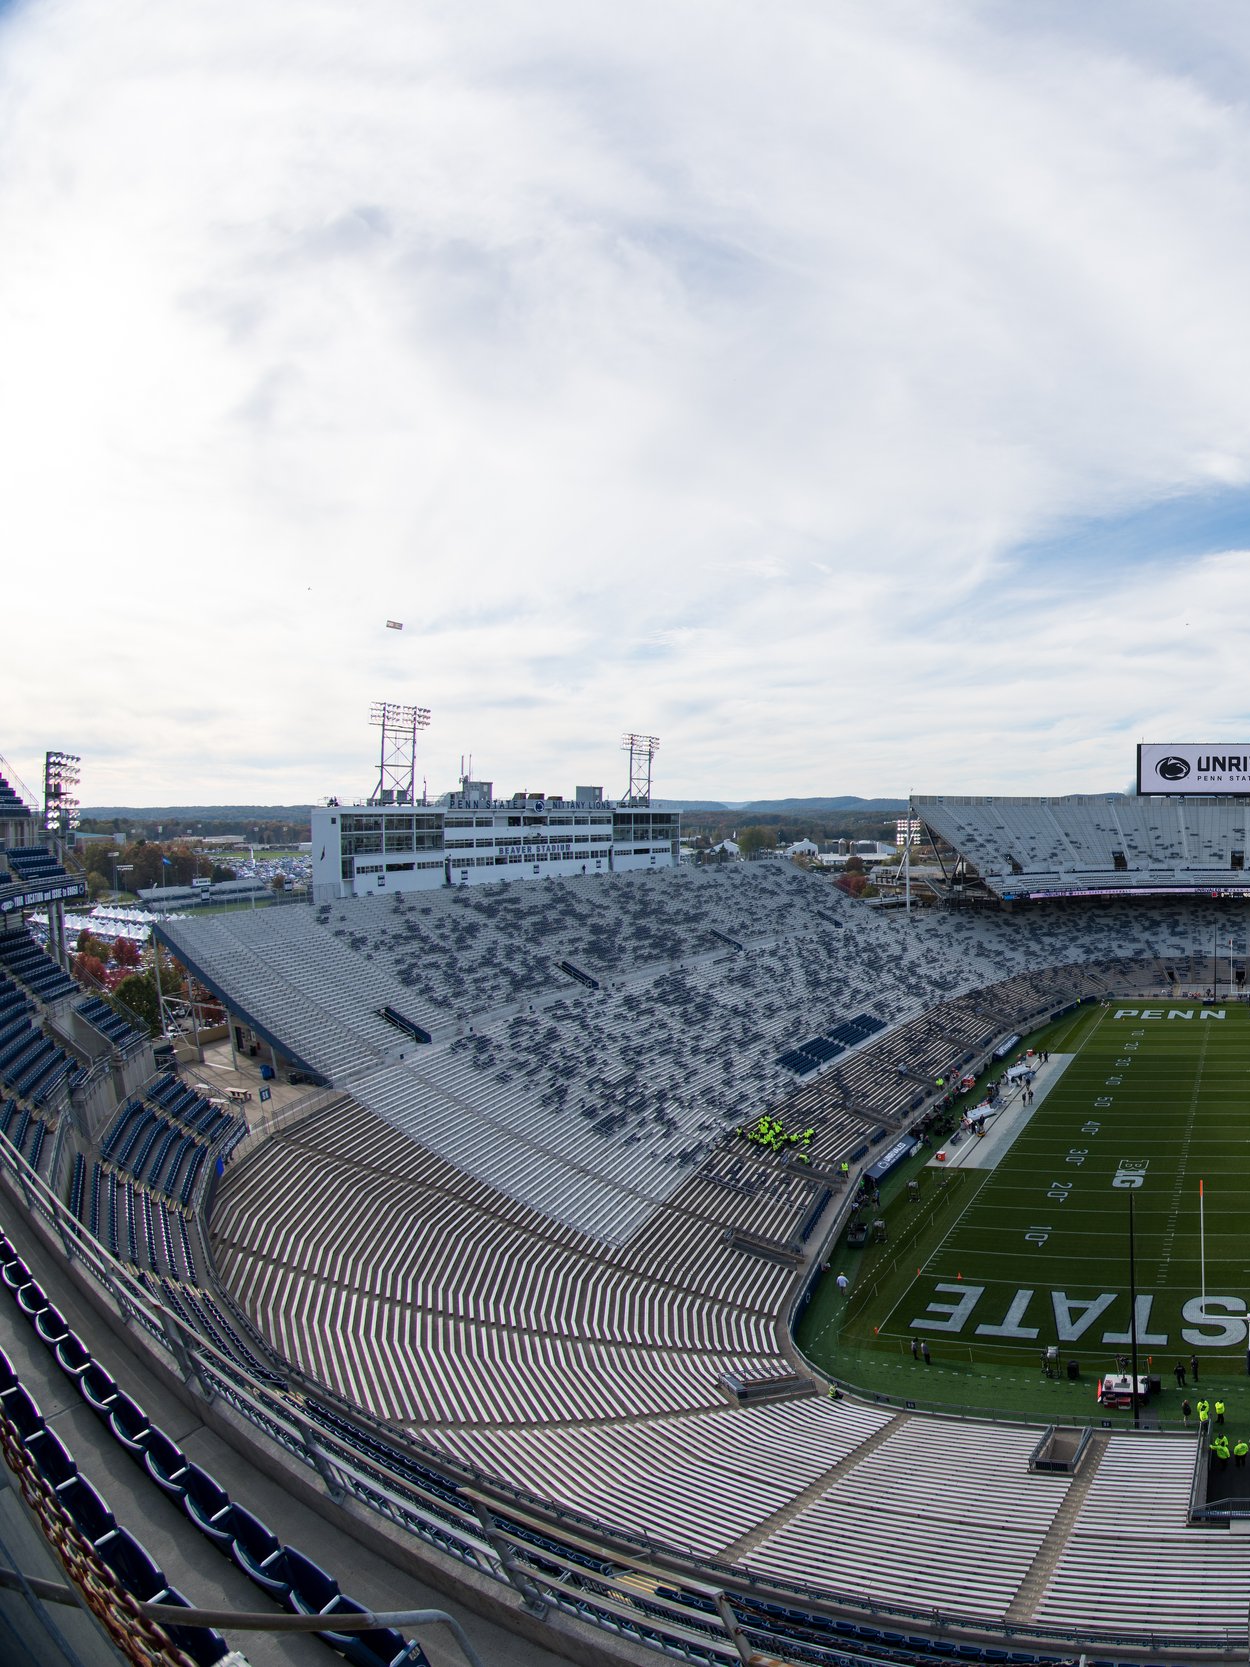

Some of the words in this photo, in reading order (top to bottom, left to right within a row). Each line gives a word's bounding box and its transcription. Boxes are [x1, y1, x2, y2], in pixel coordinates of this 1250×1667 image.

[450, 800, 479, 809] PENN
[486, 800, 518, 809] STATE
[552, 801, 585, 809] NITTANY
[588, 801, 611, 809] LIONS
[499, 846, 532, 855] BEAVER
[536, 844, 572, 853] STADIUM
[1113, 1009, 1226, 1020] PENN
[1094, 1096, 1113, 1107] 50
[1081, 1120, 1101, 1133] 40
[1065, 1148, 1089, 1162] 30
[1047, 1181, 1073, 1198] 20
[1024, 1226, 1053, 1241] 10
[908, 1282, 1249, 1347] STATE
